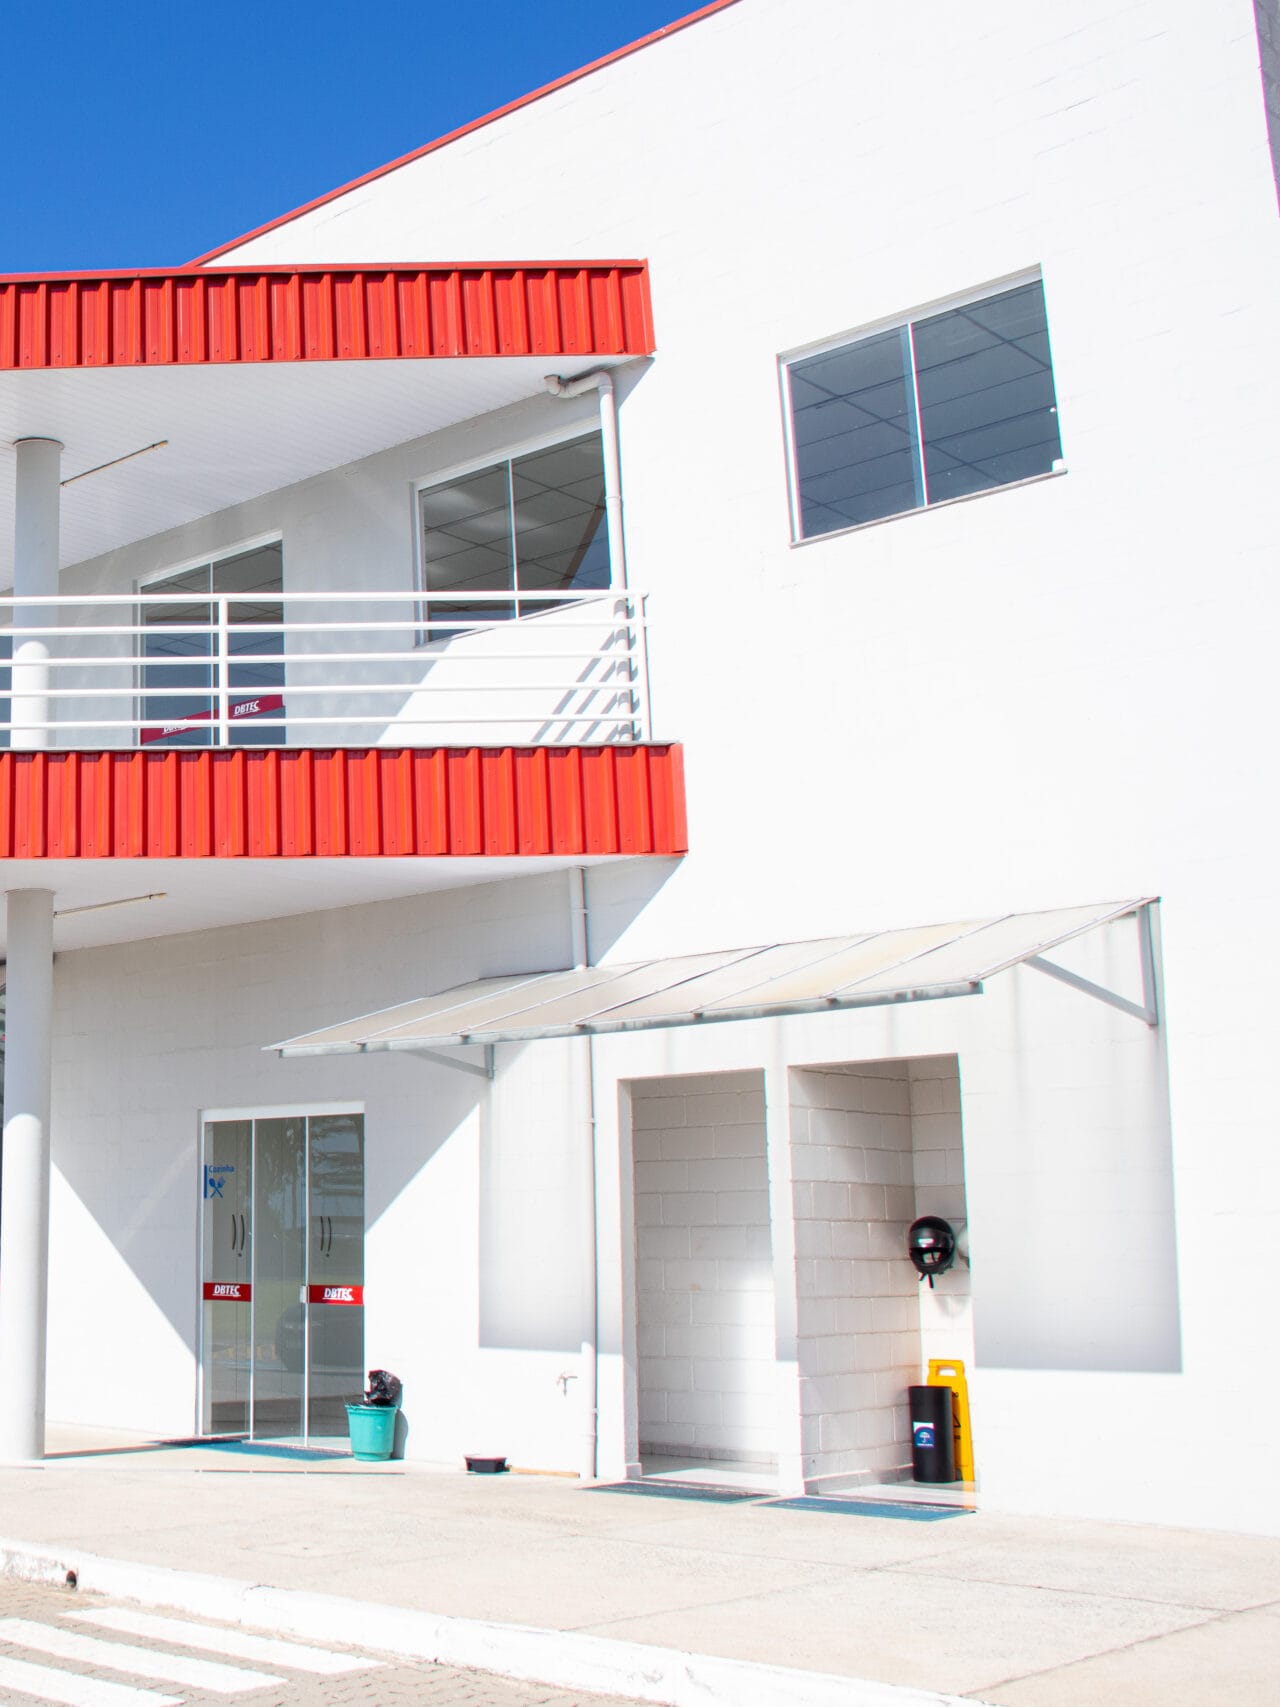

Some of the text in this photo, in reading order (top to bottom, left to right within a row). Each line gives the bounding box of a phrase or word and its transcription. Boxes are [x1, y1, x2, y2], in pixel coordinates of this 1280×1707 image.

[233, 701, 260, 715] DBTEC
[213, 1284, 241, 1296] DBTEC
[324, 1288, 353, 1299] DBTEC
